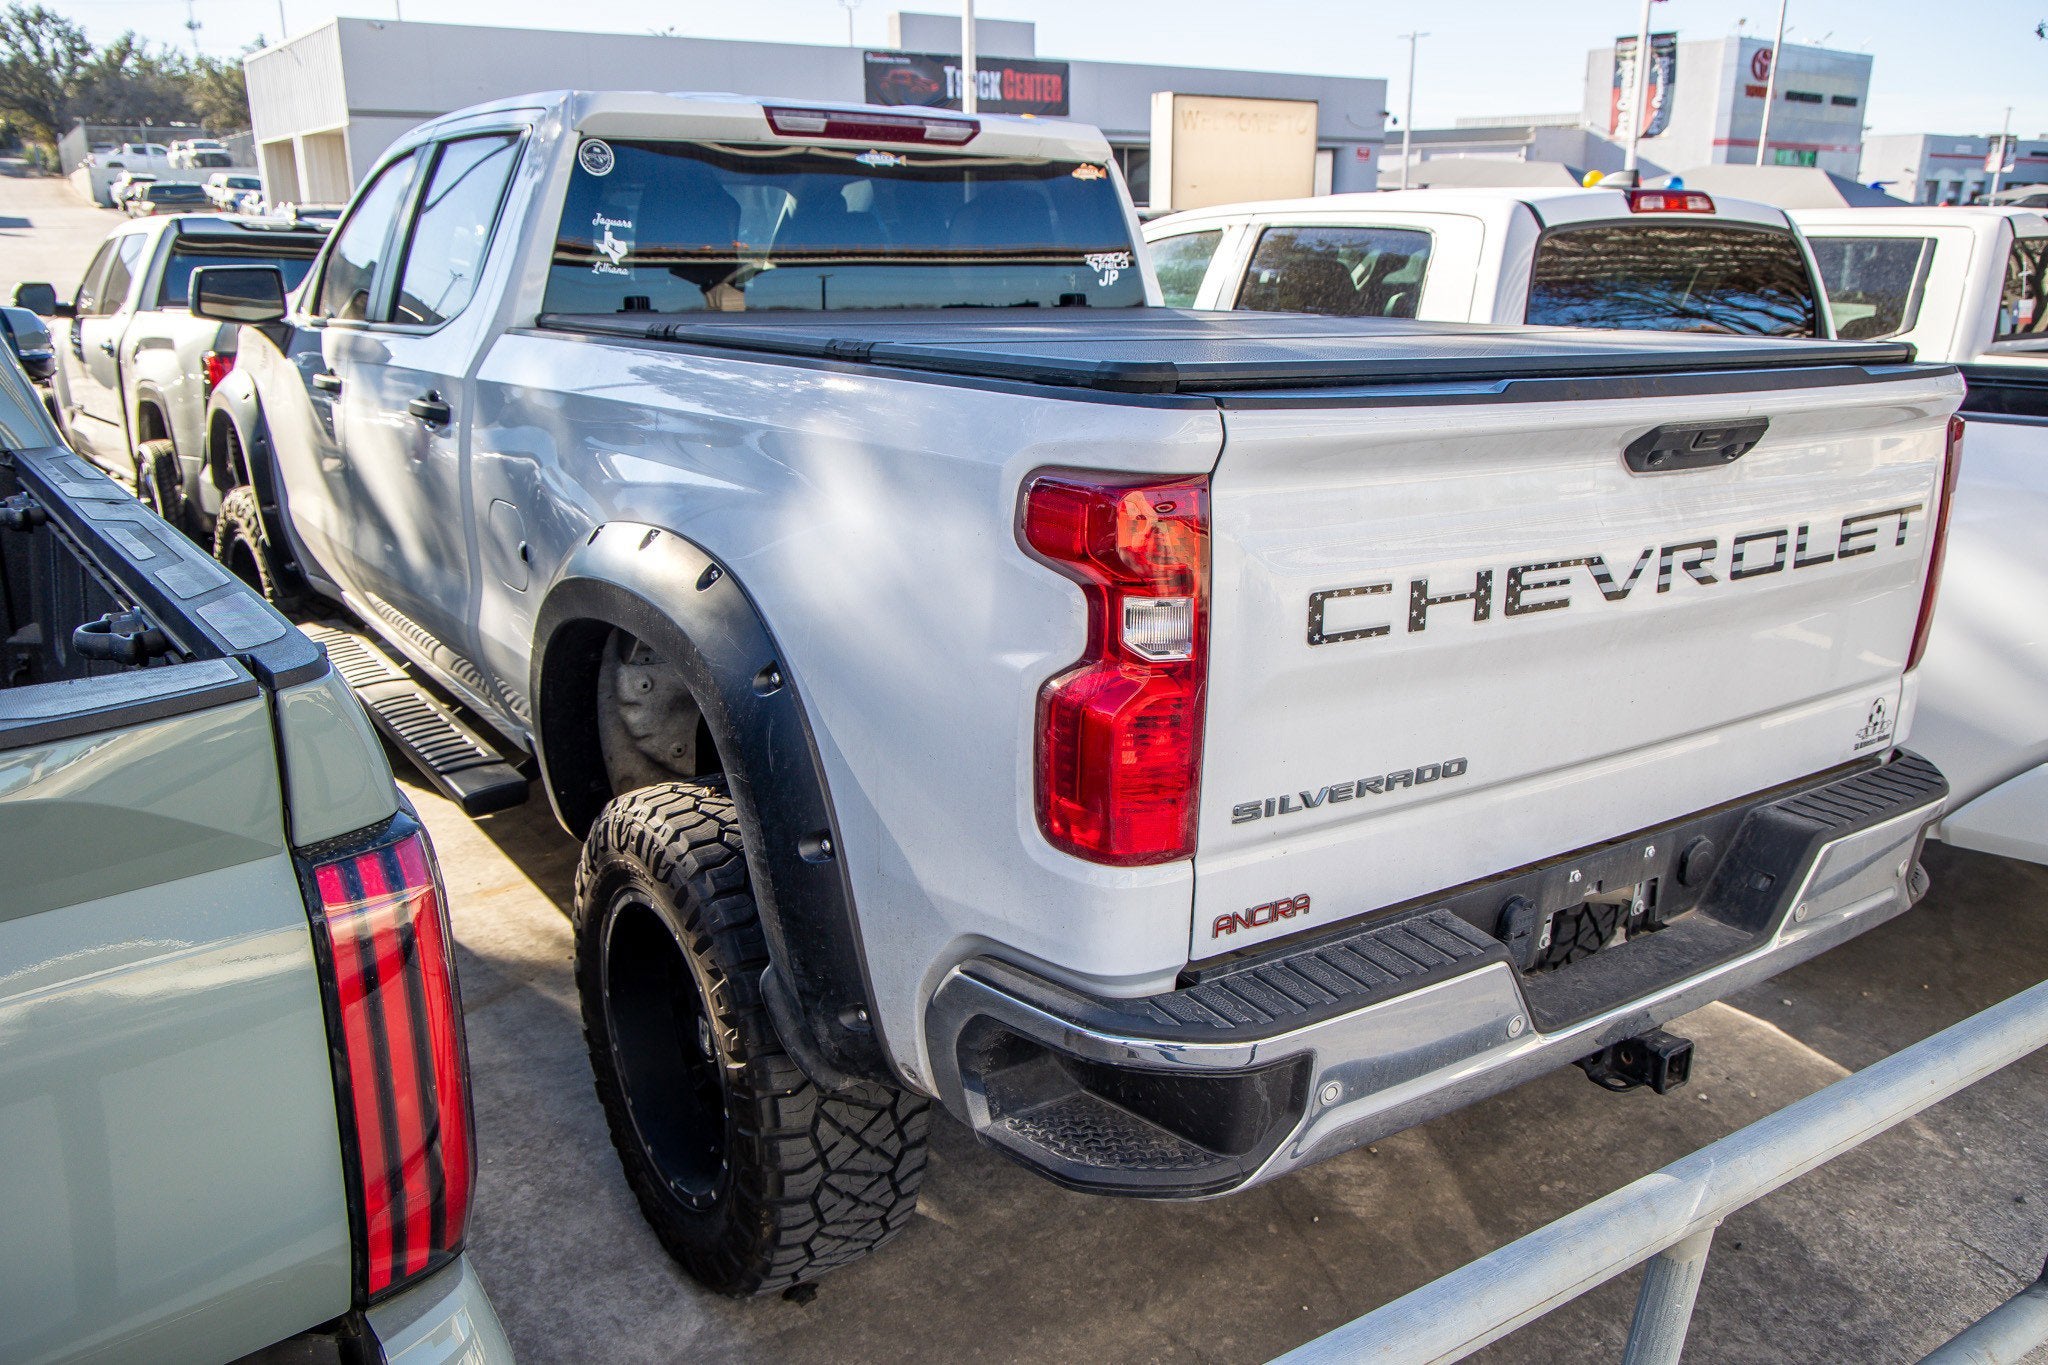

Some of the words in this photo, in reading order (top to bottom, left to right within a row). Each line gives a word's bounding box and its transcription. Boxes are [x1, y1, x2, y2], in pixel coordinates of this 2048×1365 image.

[943, 65, 1001, 100] TRCK
[1002, 67, 1063, 103] CENTER
[1098, 269, 1119, 287] JP
[1307, 504, 1923, 646] CHEVROLET
[1231, 756, 1468, 824] SILVERADO
[1211, 893, 1311, 939] ANCIRA
